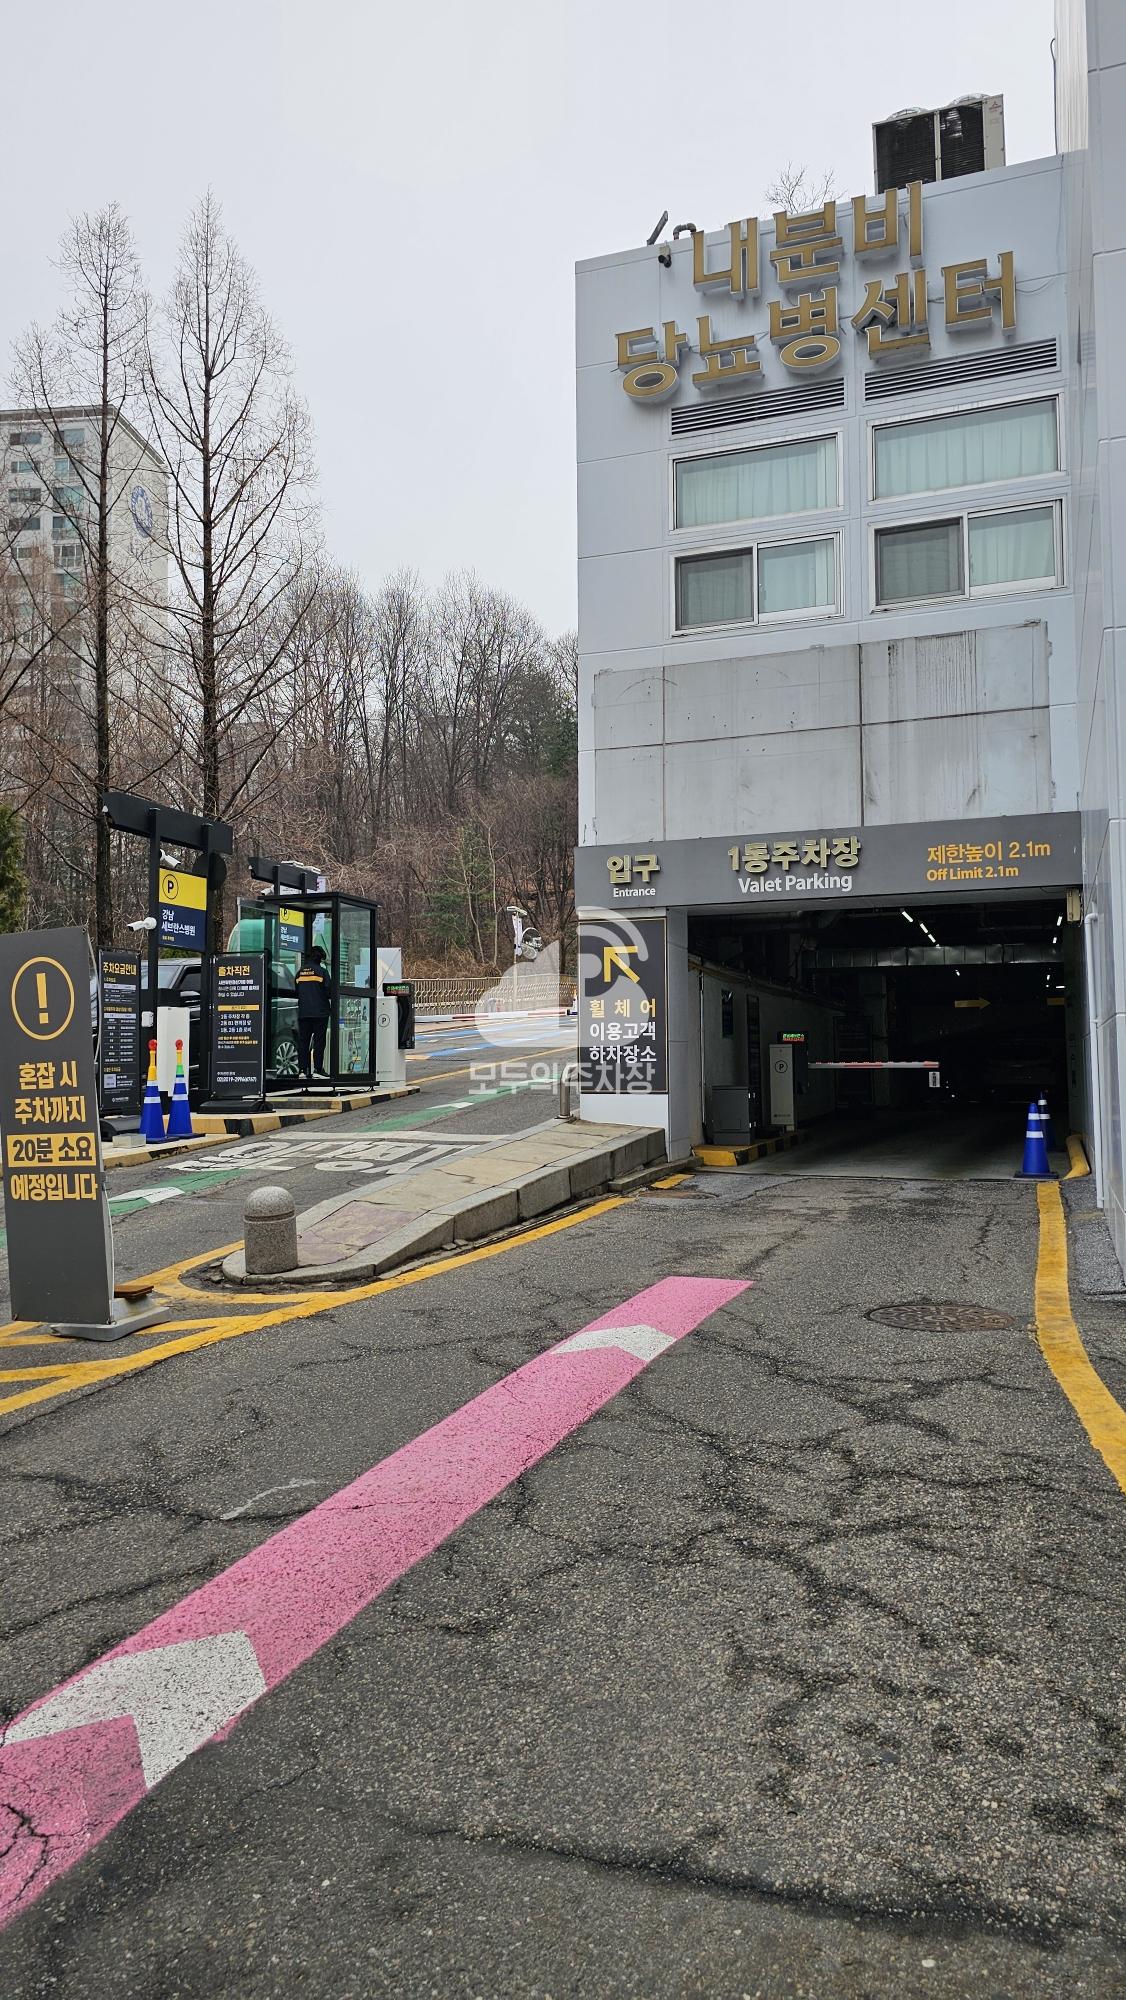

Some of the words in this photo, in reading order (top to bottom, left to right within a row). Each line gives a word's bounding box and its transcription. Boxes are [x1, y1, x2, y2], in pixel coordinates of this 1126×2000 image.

[692, 181, 923, 295] 내분비
[615, 251, 1016, 402] 당뇨병센터
[728, 836, 862, 874] 1동주차장
[927, 842, 1003, 864] 제한높이
[1008, 841, 1051, 860] 2.1m
[607, 855, 660, 885] 입구
[927, 867, 948, 881] Off
[949, 866, 984, 880] Limit
[985, 865, 1019, 879] 2.1m
[613, 887, 656, 899] Entrance
[738, 877, 783, 895] Valet
[785, 873, 853, 894] Parking
[162, 909, 175, 921] 강남
[161, 921, 196, 937] 세브란스병원
[103, 962, 137, 976] 주차요금안내
[589, 1022, 656, 1041] 이용고객
[589, 1045, 657, 1064] 하차장소
[18, 1062, 56, 1090] 혼잡
[60, 1060, 78, 1087] 시
[14, 1096, 87, 1125] 주차까지
[13, 1136, 53, 1163] 20분
[58, 1135, 93, 1162] 소요
[10, 1173, 98, 1201] 예정입니다
